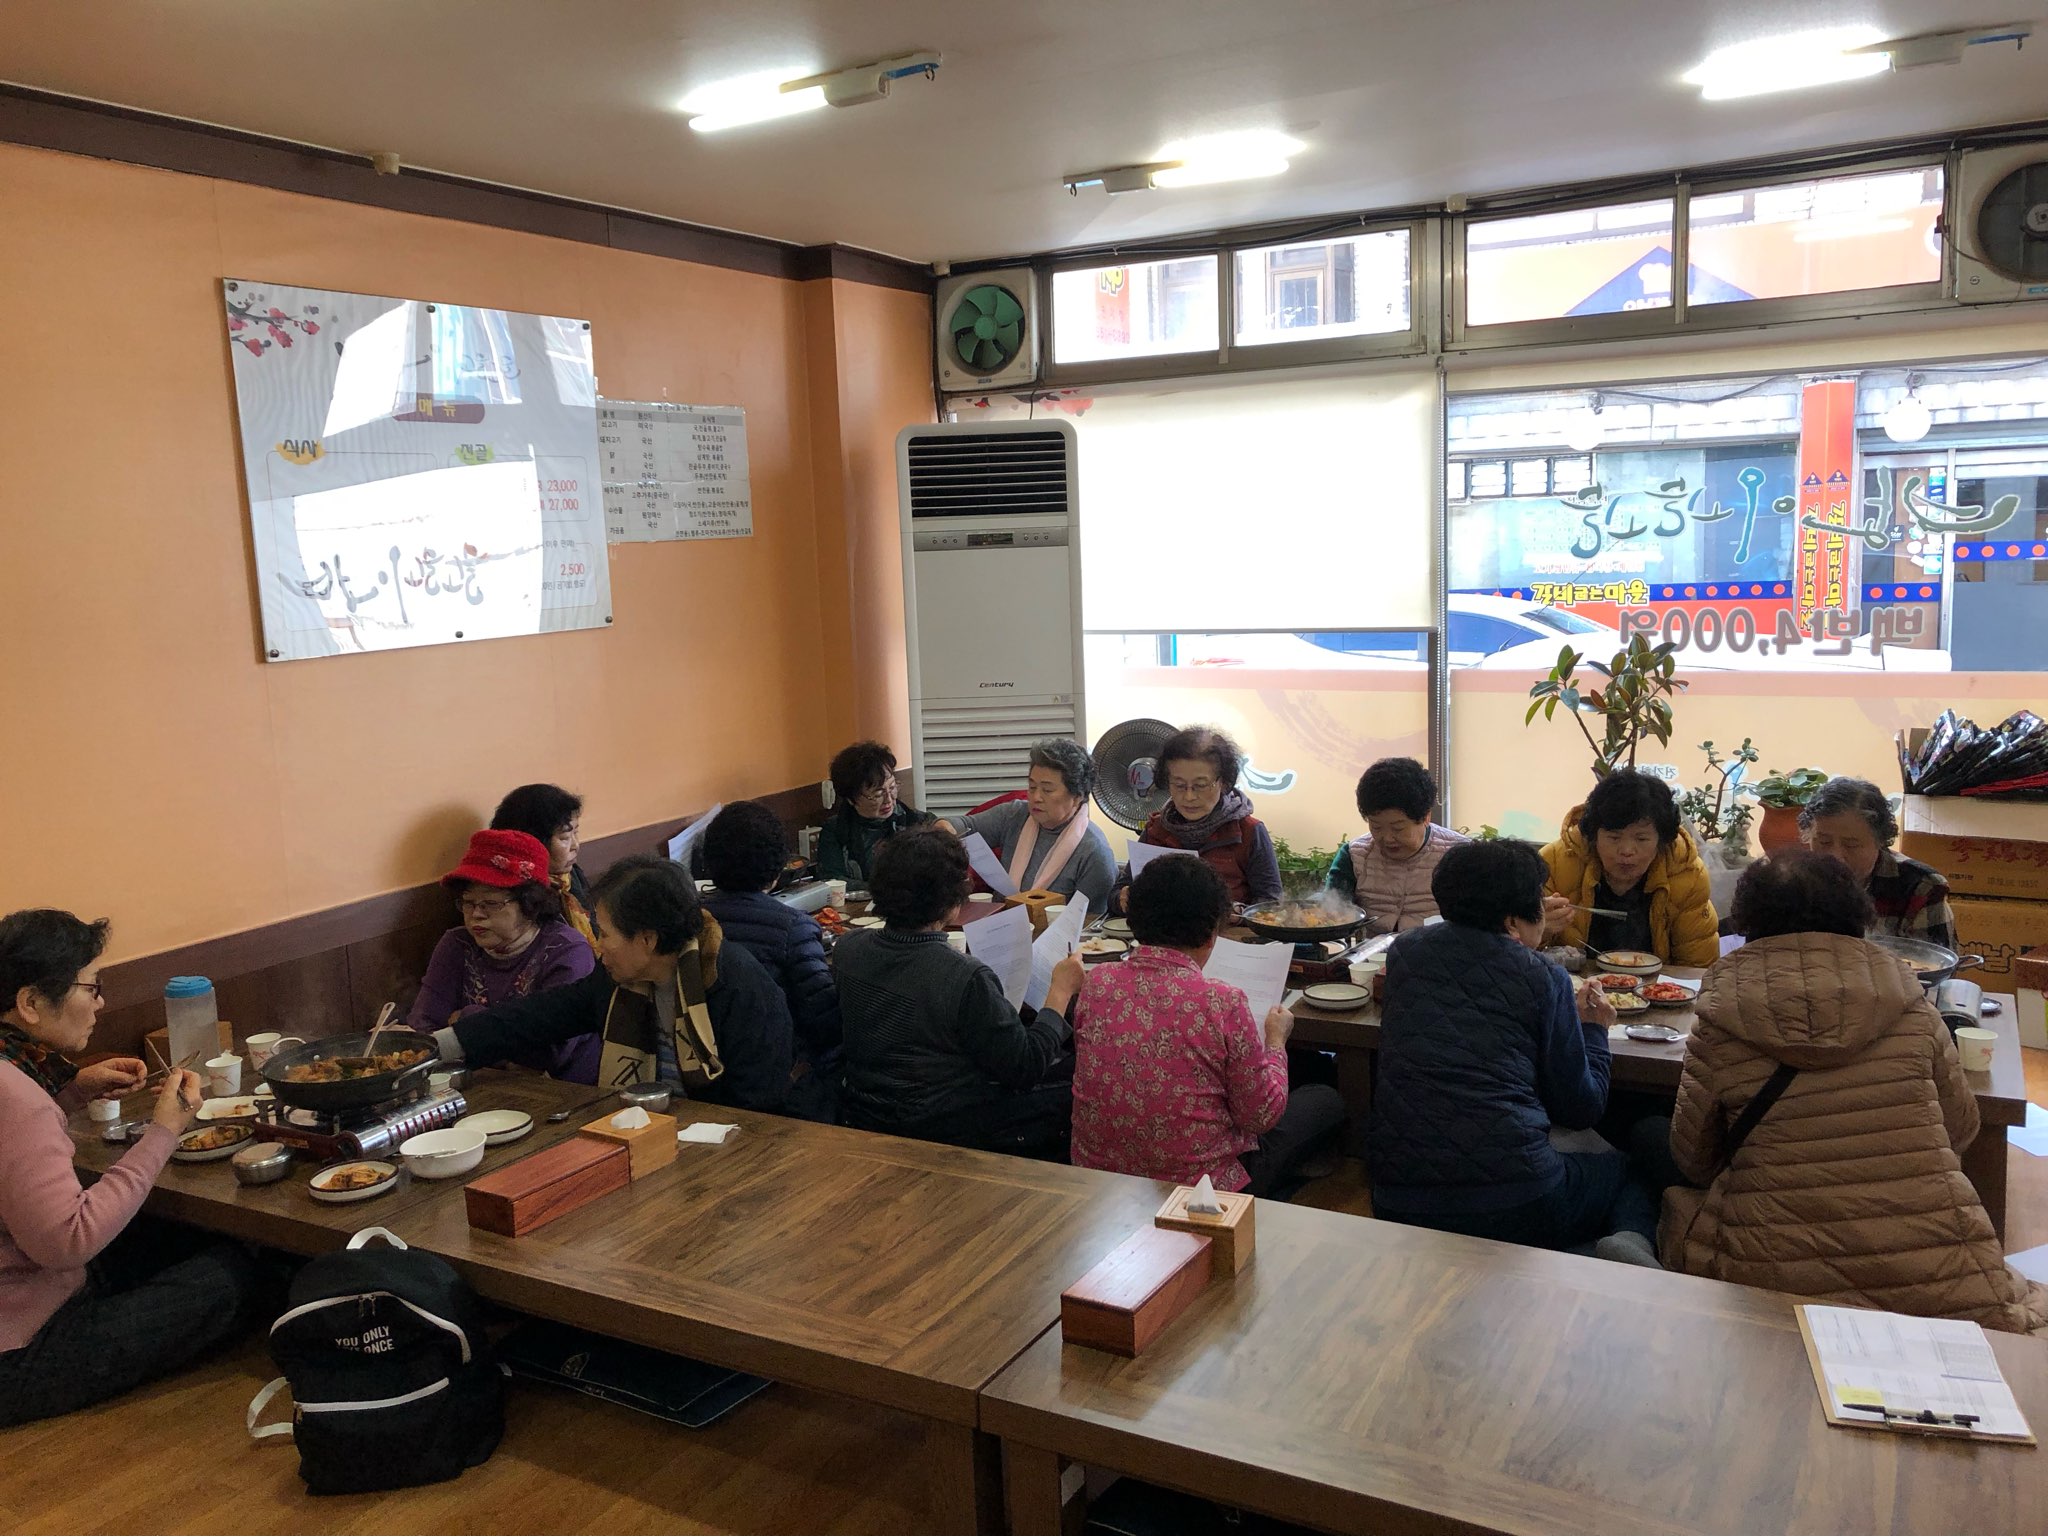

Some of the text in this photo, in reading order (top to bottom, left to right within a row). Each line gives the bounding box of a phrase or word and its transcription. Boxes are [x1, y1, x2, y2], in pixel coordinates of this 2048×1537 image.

[599, 436, 622, 444] 돼지고기
[641, 437, 653, 446] 국산
[283, 438, 317, 458] 식사
[461, 443, 488, 461] 전골
[547, 479, 578, 493] 23,000
[549, 498, 579, 512] 27,000
[560, 562, 585, 576] 2,500
[979, 681, 1014, 689] Century
[335, 1326, 389, 1347] YOU ONLY
[363, 1339, 394, 1354] ONCE
